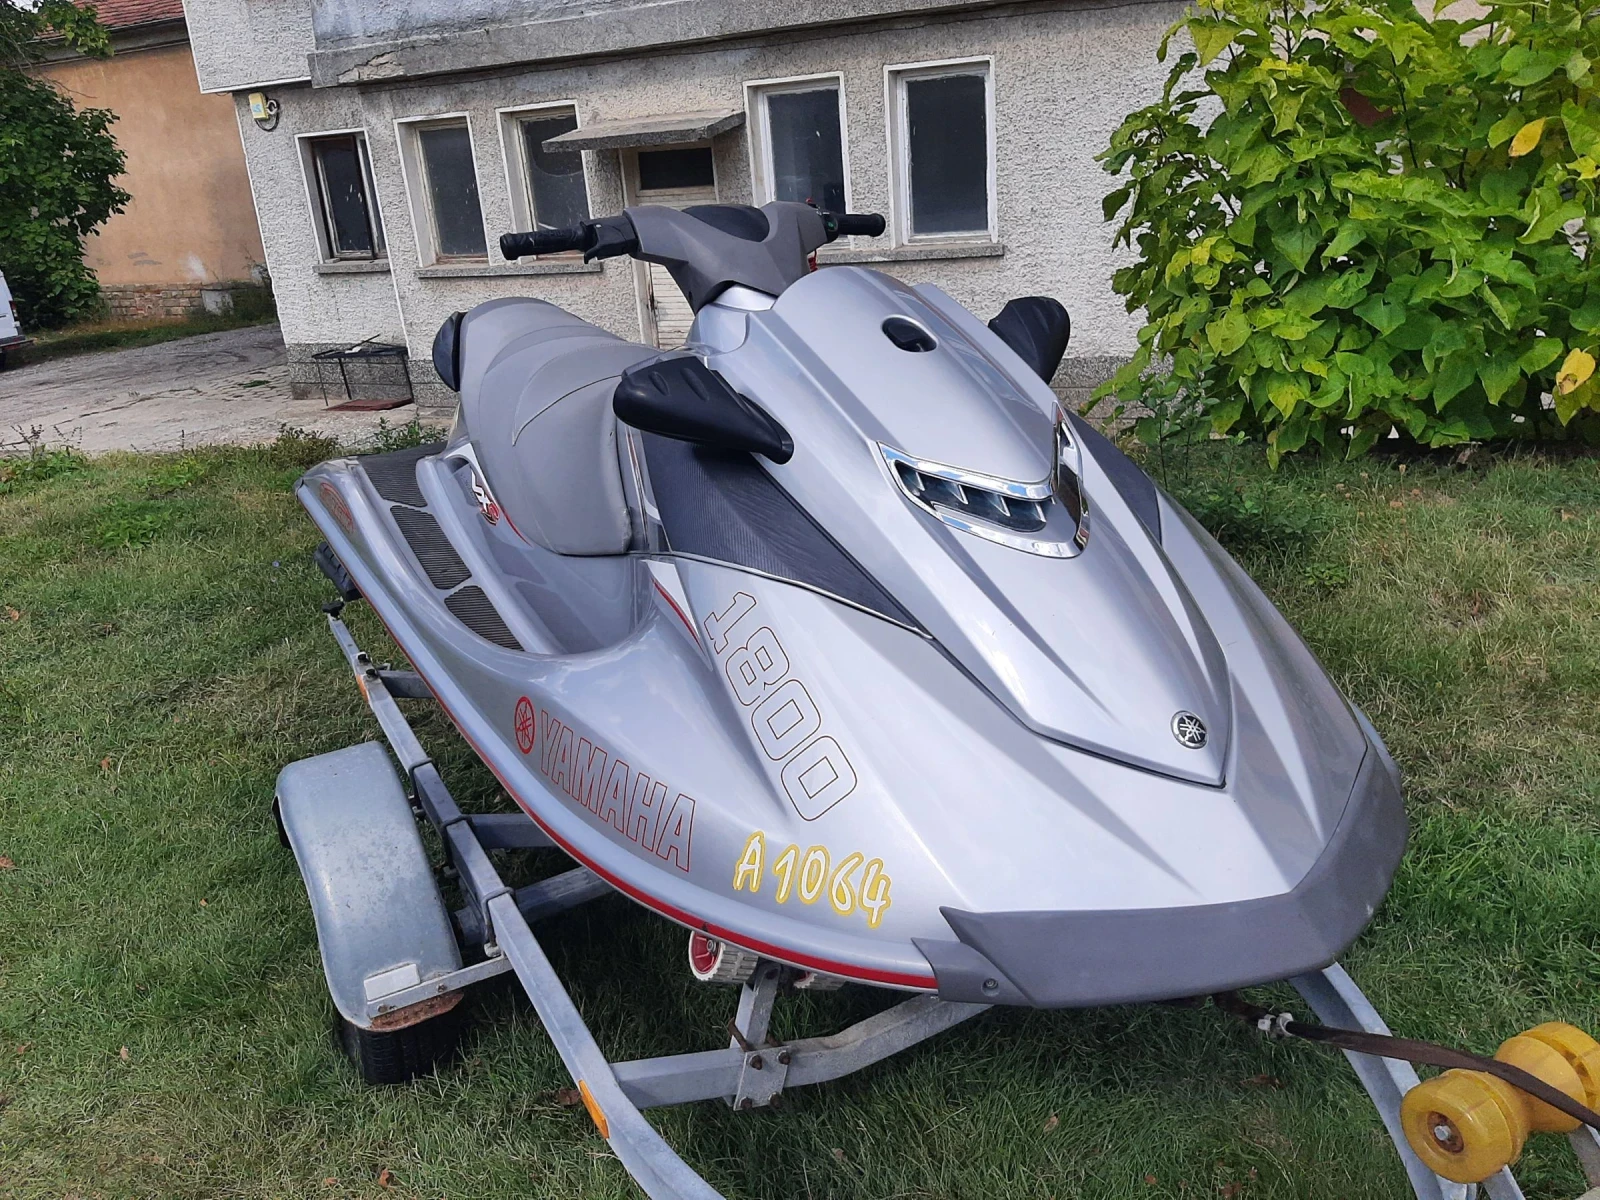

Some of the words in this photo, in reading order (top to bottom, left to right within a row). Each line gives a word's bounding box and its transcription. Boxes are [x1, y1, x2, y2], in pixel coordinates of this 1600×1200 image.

[704, 592, 857, 821] 1800
[540, 710, 696, 872] YAMAHA
[733, 831, 765, 892] A
[773, 843, 891, 928] 1064
